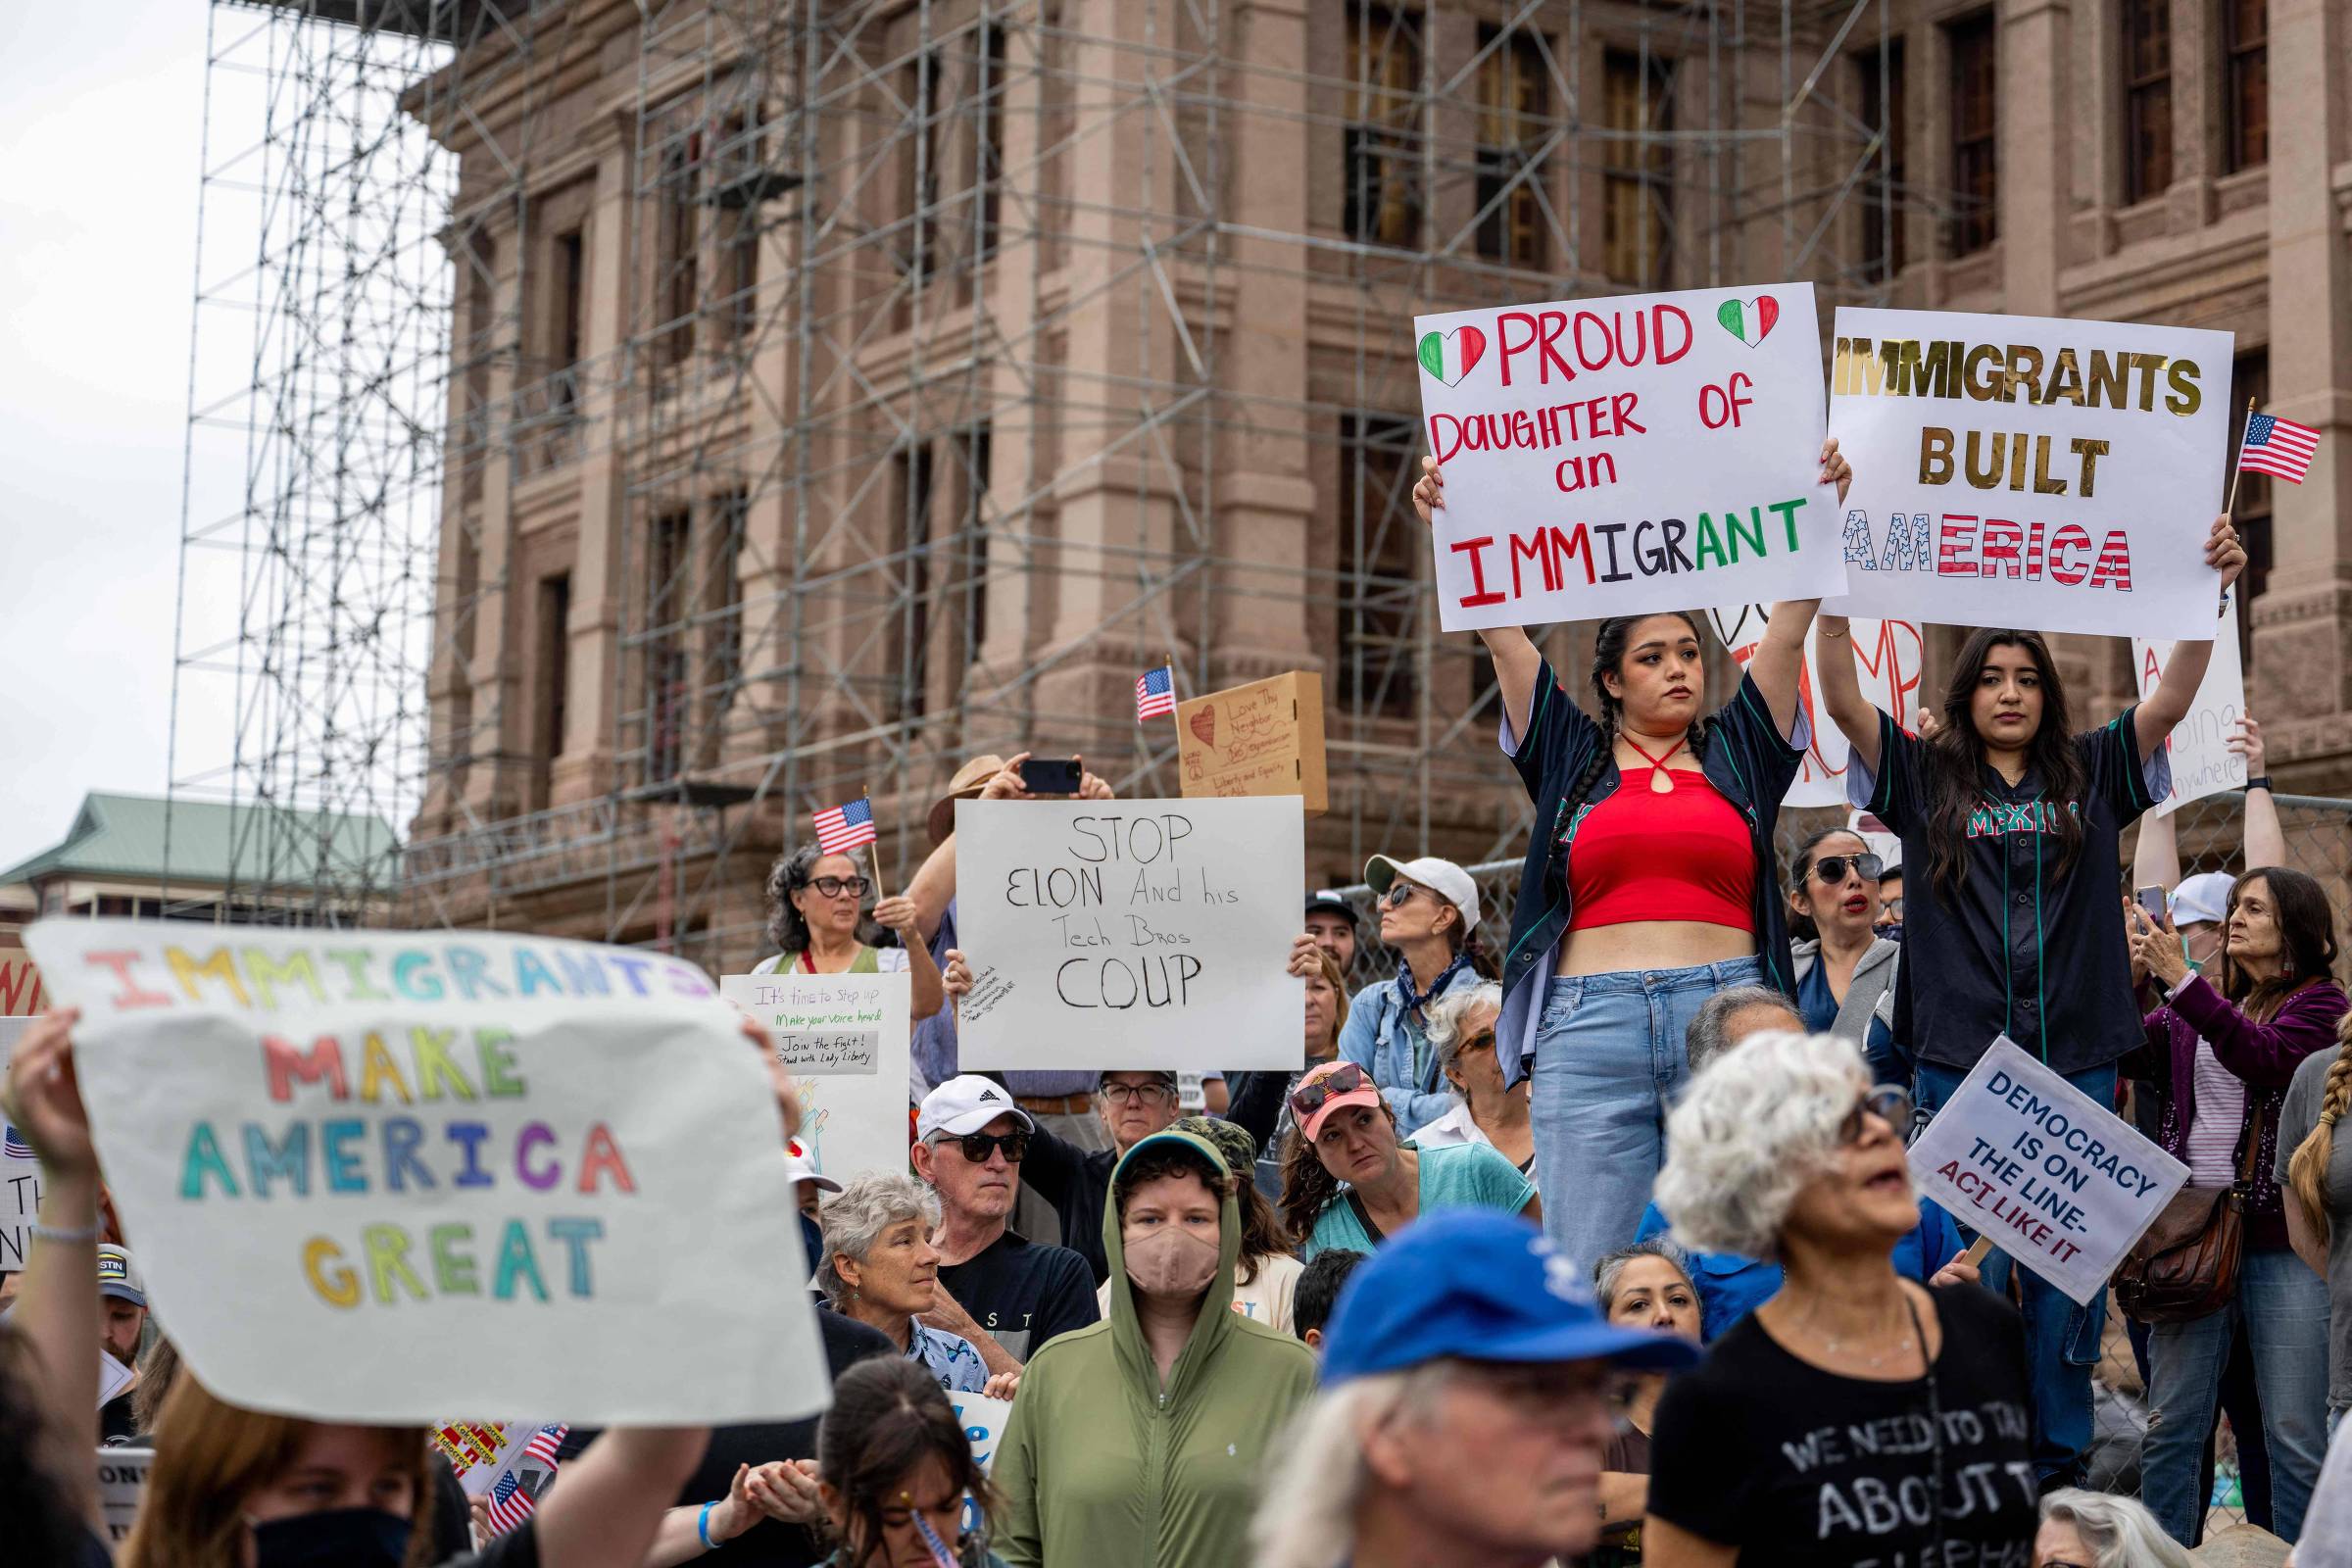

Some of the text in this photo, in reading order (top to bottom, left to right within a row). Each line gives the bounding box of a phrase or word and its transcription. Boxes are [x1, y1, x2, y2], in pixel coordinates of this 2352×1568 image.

[1496, 304, 1693, 387] PROUD
[1834, 337, 2202, 417] IMMIGRANTS
[1555, 452, 1617, 492] an
[1918, 425, 2110, 498] BUILT
[1449, 497, 1807, 608] IMMIGRANT
[1842, 510, 2132, 592] AMERICA
[2166, 705, 2237, 753] oing
[1068, 814, 1192, 864] STOP
[1006, 866, 1102, 907] ELON
[1201, 866, 1239, 905] his
[1052, 913, 1111, 949] Tech
[85, 945, 711, 1009] IMMIGRANTS
[755, 986, 785, 1004] It's
[1056, 954, 1201, 1009] COUP
[260, 1026, 527, 1105] MAKE
[813, 1037, 830, 1051] the
[179, 1116, 638, 1200] AMERICA
[1985, 1070, 2158, 1199] DEMOCRACY
[2012, 1130, 2089, 1194] IS ON
[1936, 1159, 2082, 1263] ACT LIKE IT
[1968, 1136, 2087, 1233] THE LINE-
[100, 1260, 122, 1271] STIN
[301, 1216, 605, 1309] GREAT
[1782, 1426, 1846, 1473] WE
[1848, 1414, 1936, 1454] NEED
[1939, 1409, 1984, 1446] TO
[1818, 1462, 1997, 1540] ABOUT
